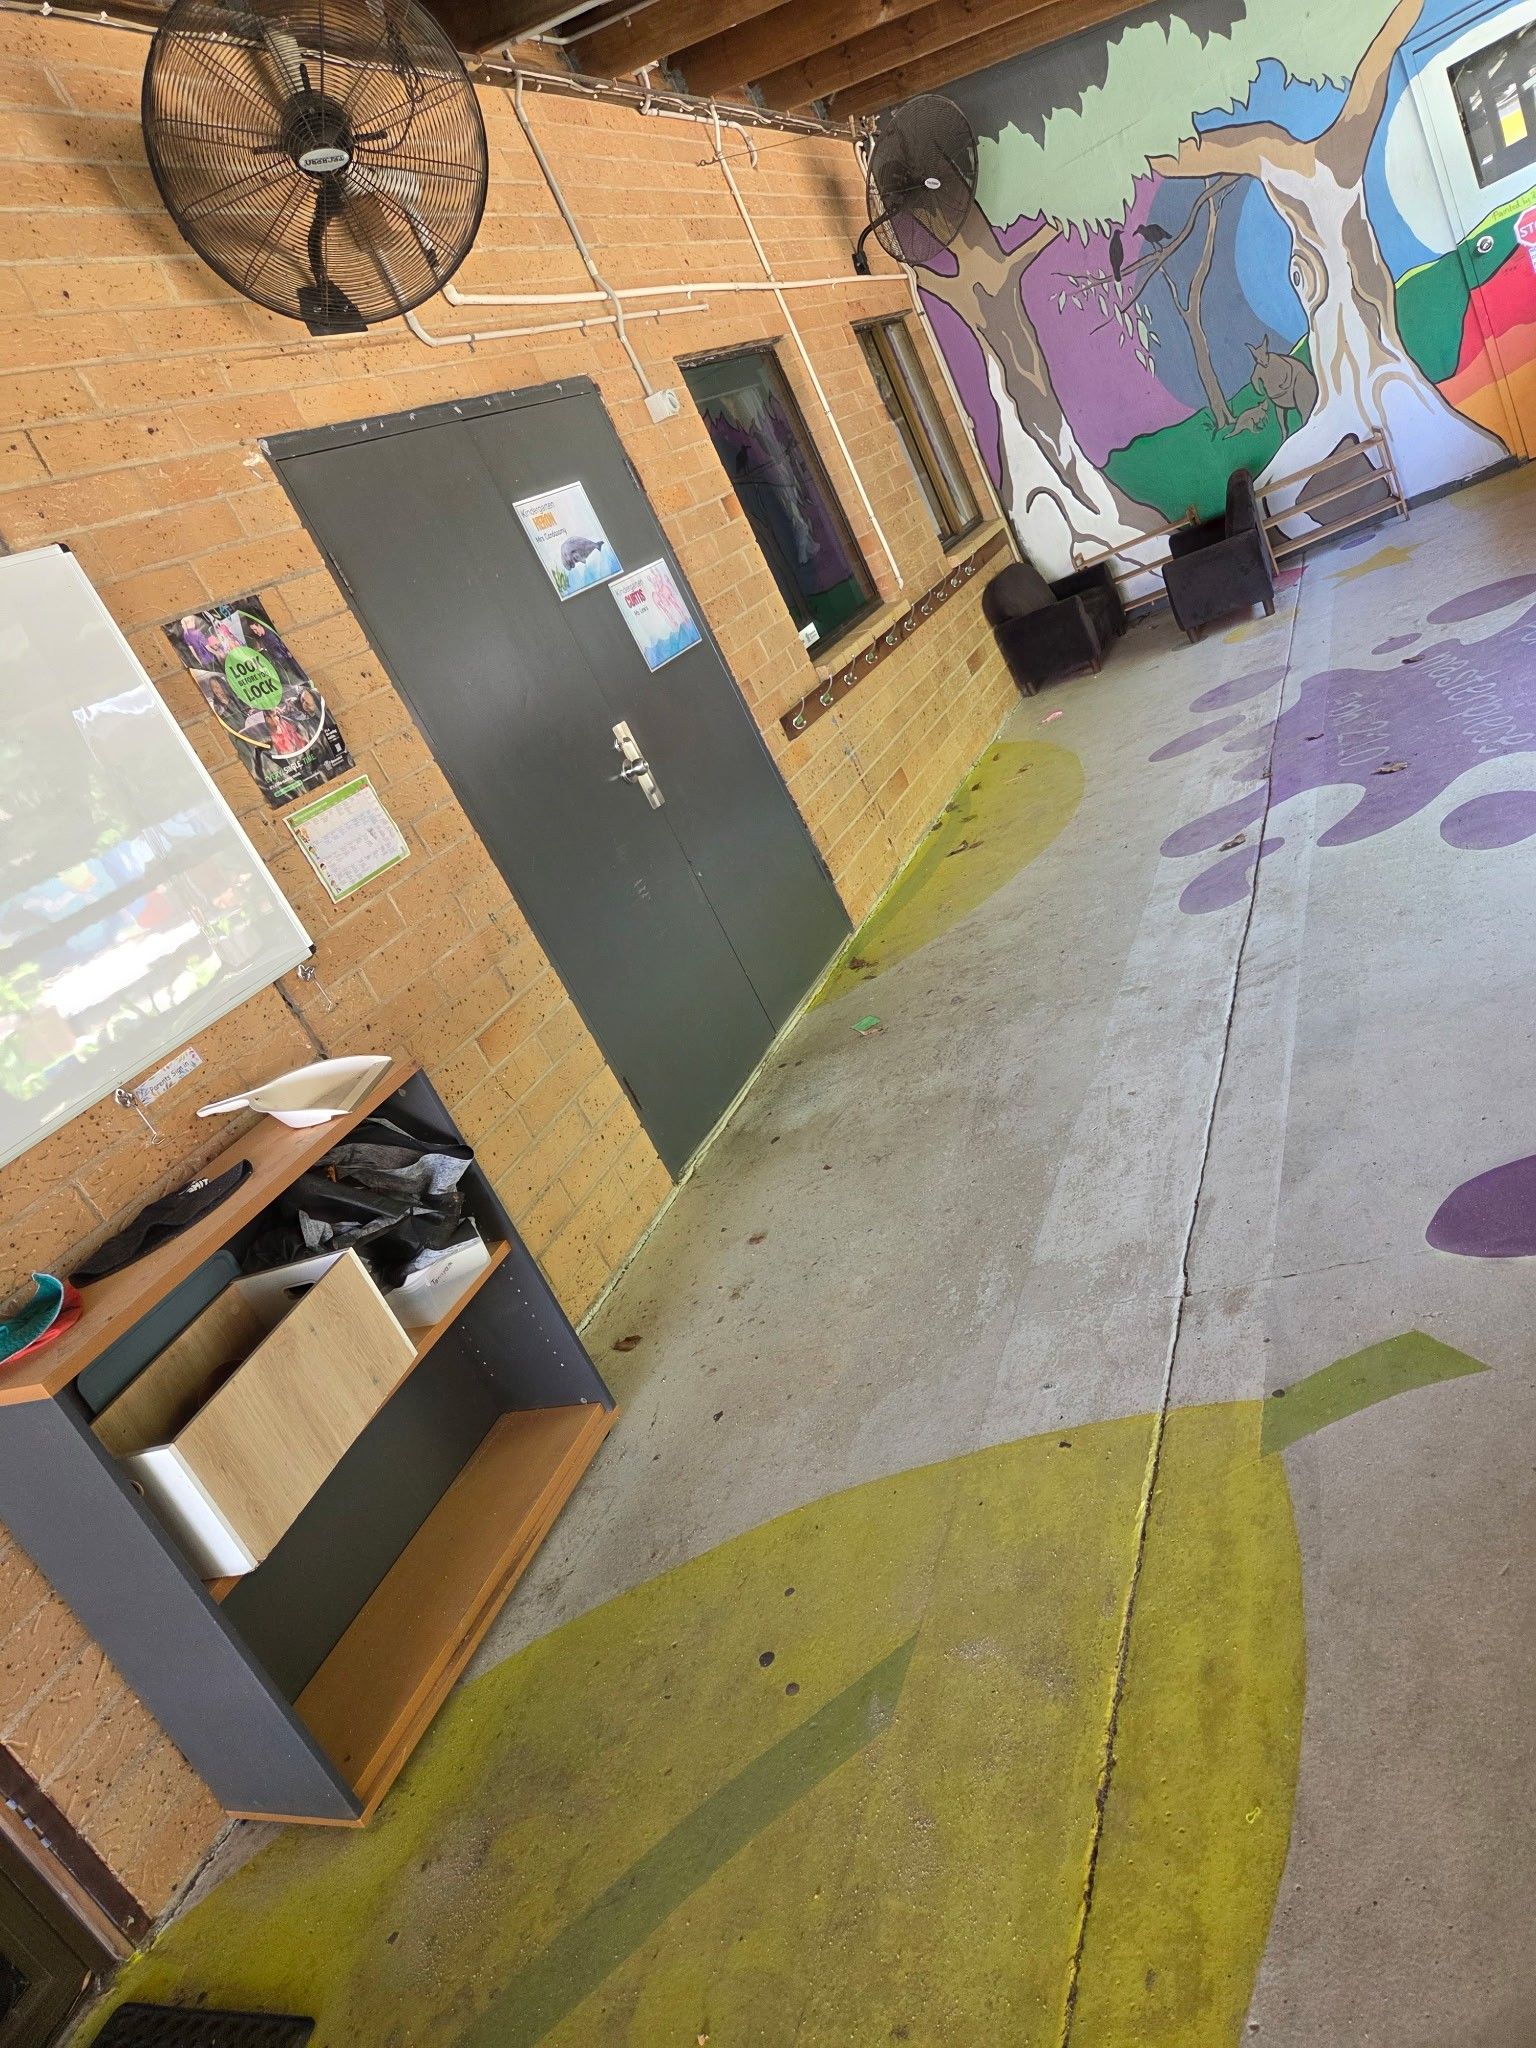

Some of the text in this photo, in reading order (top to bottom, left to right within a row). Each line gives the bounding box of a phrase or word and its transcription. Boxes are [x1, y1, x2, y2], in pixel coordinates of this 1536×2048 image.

[1520, 221, 1536, 238] ST
[521, 501, 555, 518] Kindergarten
[624, 588, 646, 608] CURTIS
[229, 656, 264, 679] LOOK
[237, 674, 258, 687] BEFORE
[243, 678, 279, 702] LOCK
[1409, 649, 1536, 754] masterpiece
[150, 1073, 172, 1094] Parents
[171, 1064, 183, 1079] Sign
